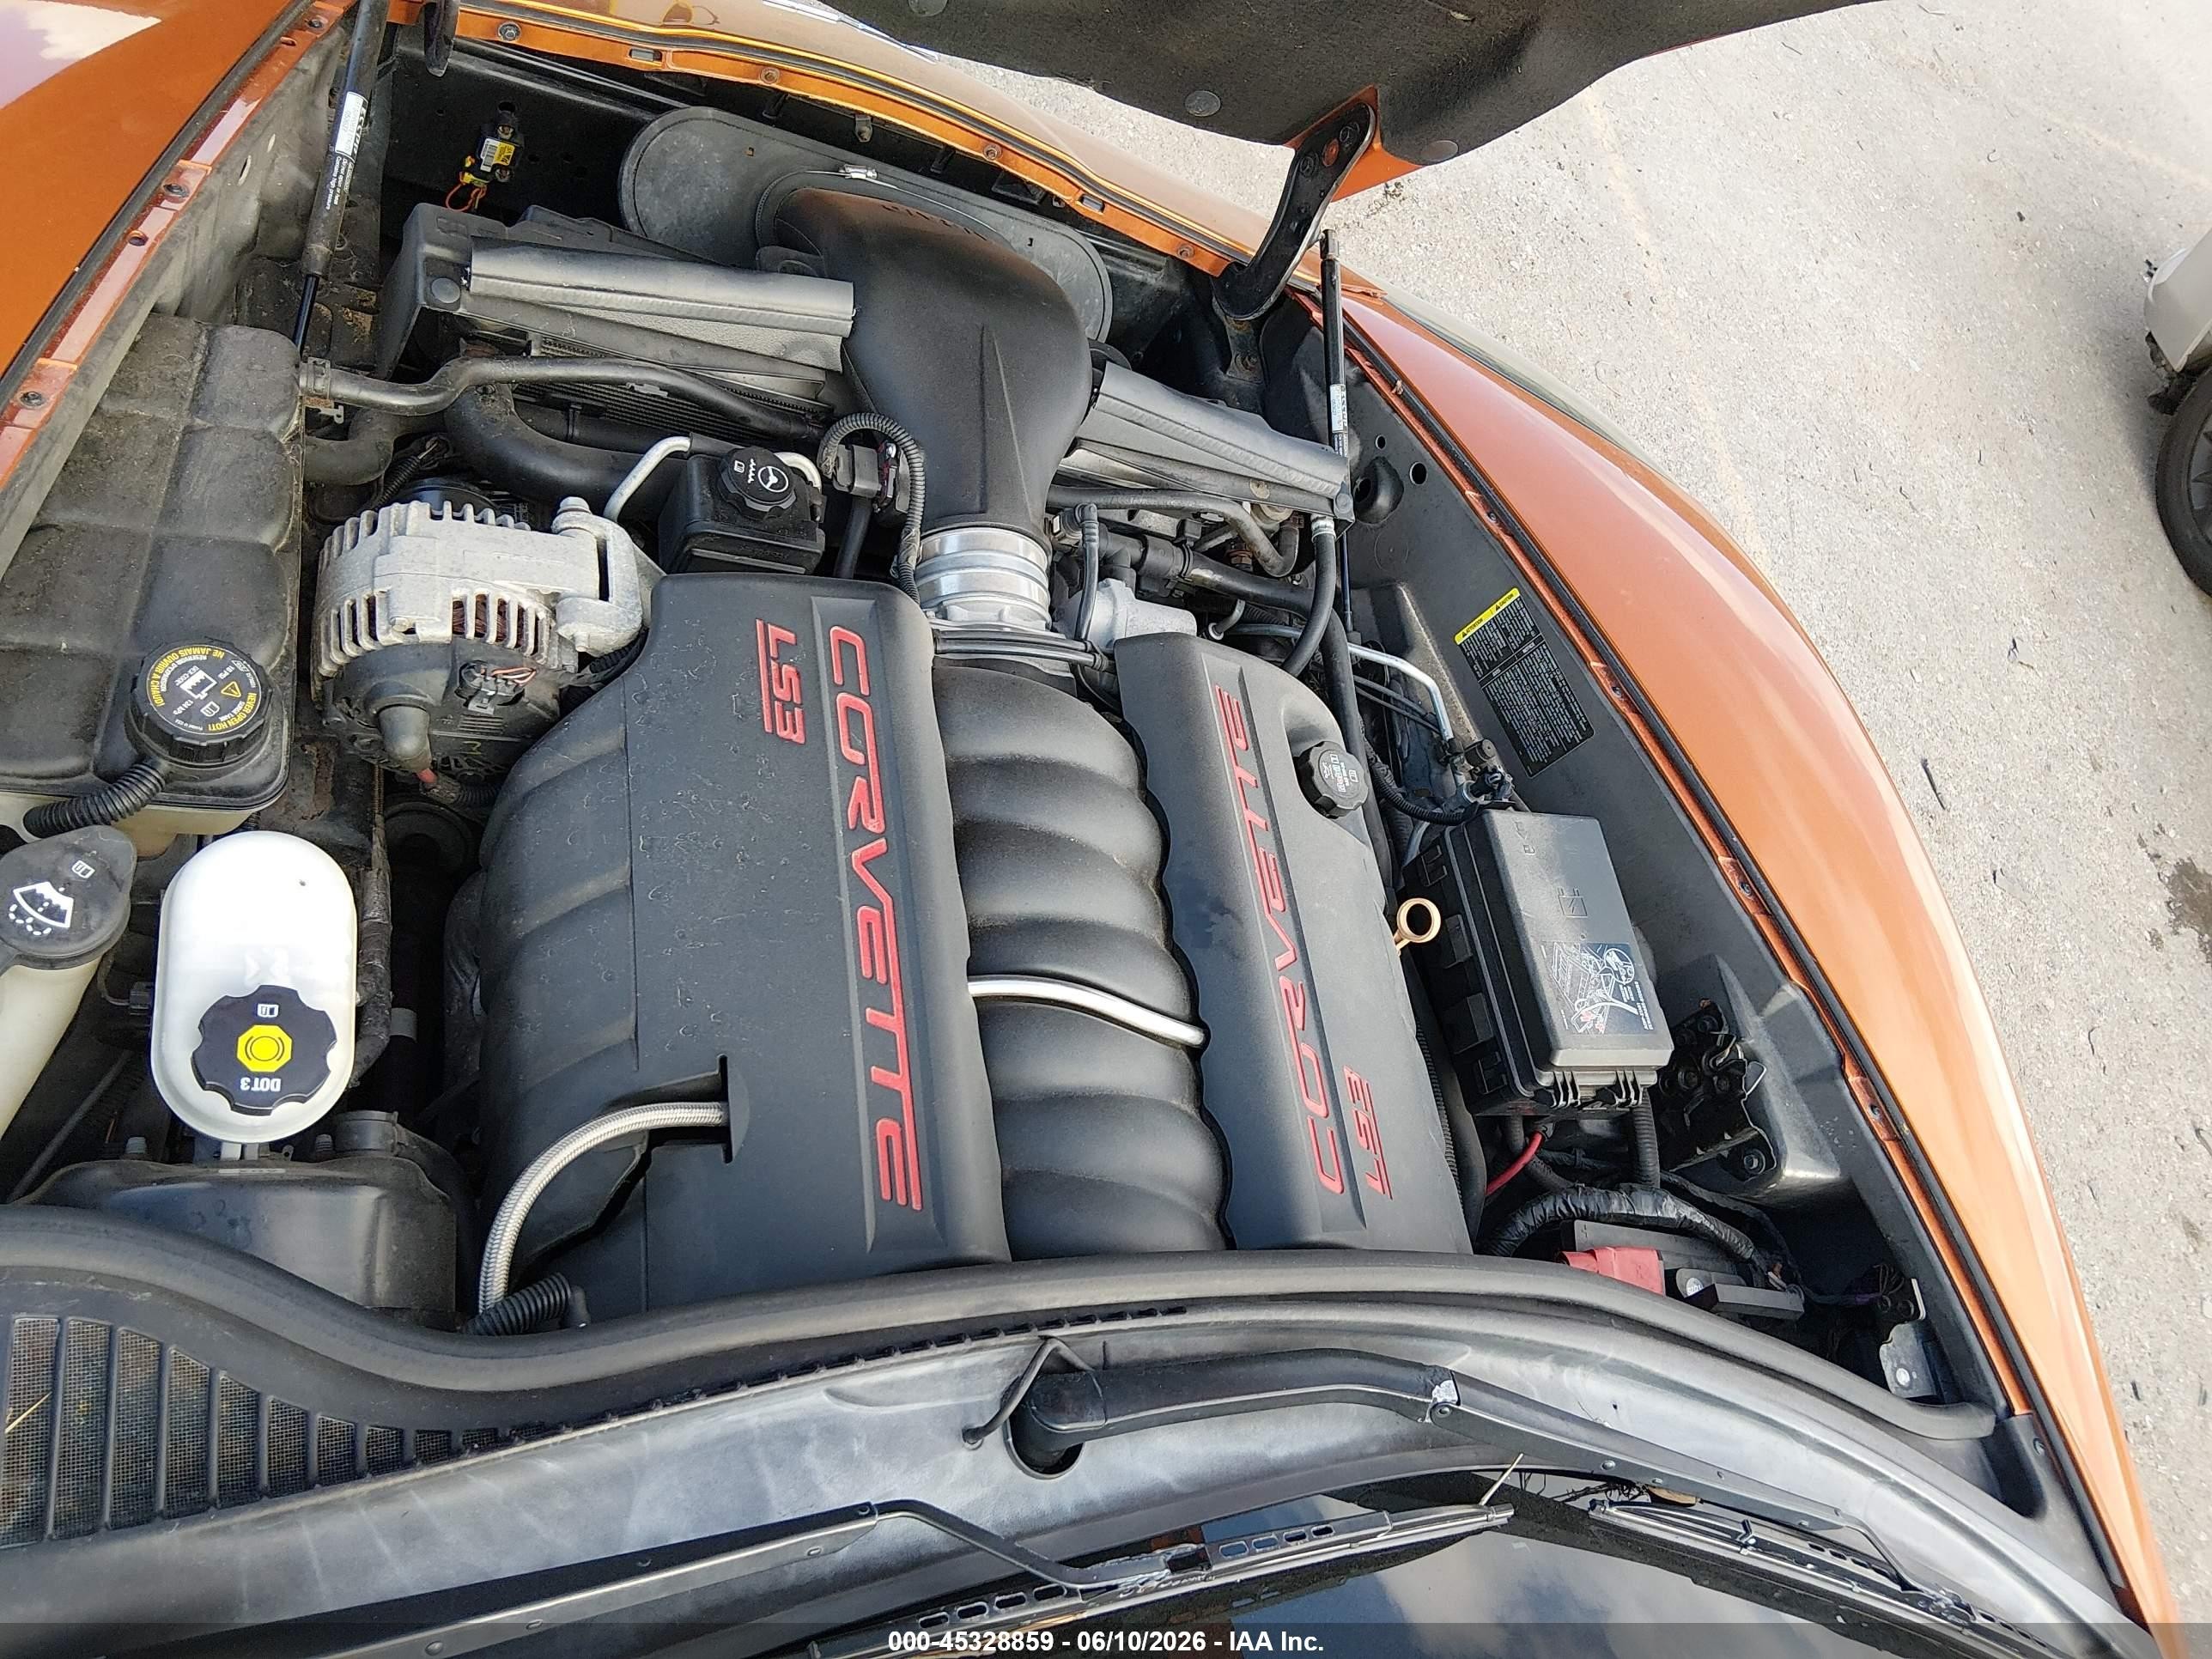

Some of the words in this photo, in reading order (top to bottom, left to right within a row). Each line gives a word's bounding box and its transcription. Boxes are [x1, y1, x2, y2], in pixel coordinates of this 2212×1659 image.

[179, 647, 211, 657] JAMAIS
[212, 649, 225, 659] NE
[155, 652, 179, 675] OUVRIR
[757, 618, 805, 744] LS3
[150, 679, 166, 708] CHAUD!
[246, 692, 258, 714] NEVER
[207, 720, 228, 732] HOT!
[228, 710, 247, 727] OPEN
[830, 625, 923, 1212] CORVETTE
[1215, 684, 1344, 1194] CORVETTE
[240, 1077, 251, 1091] 3
[251, 1078, 282, 1091] DOT
[1344, 1065, 1393, 1200] LS3
